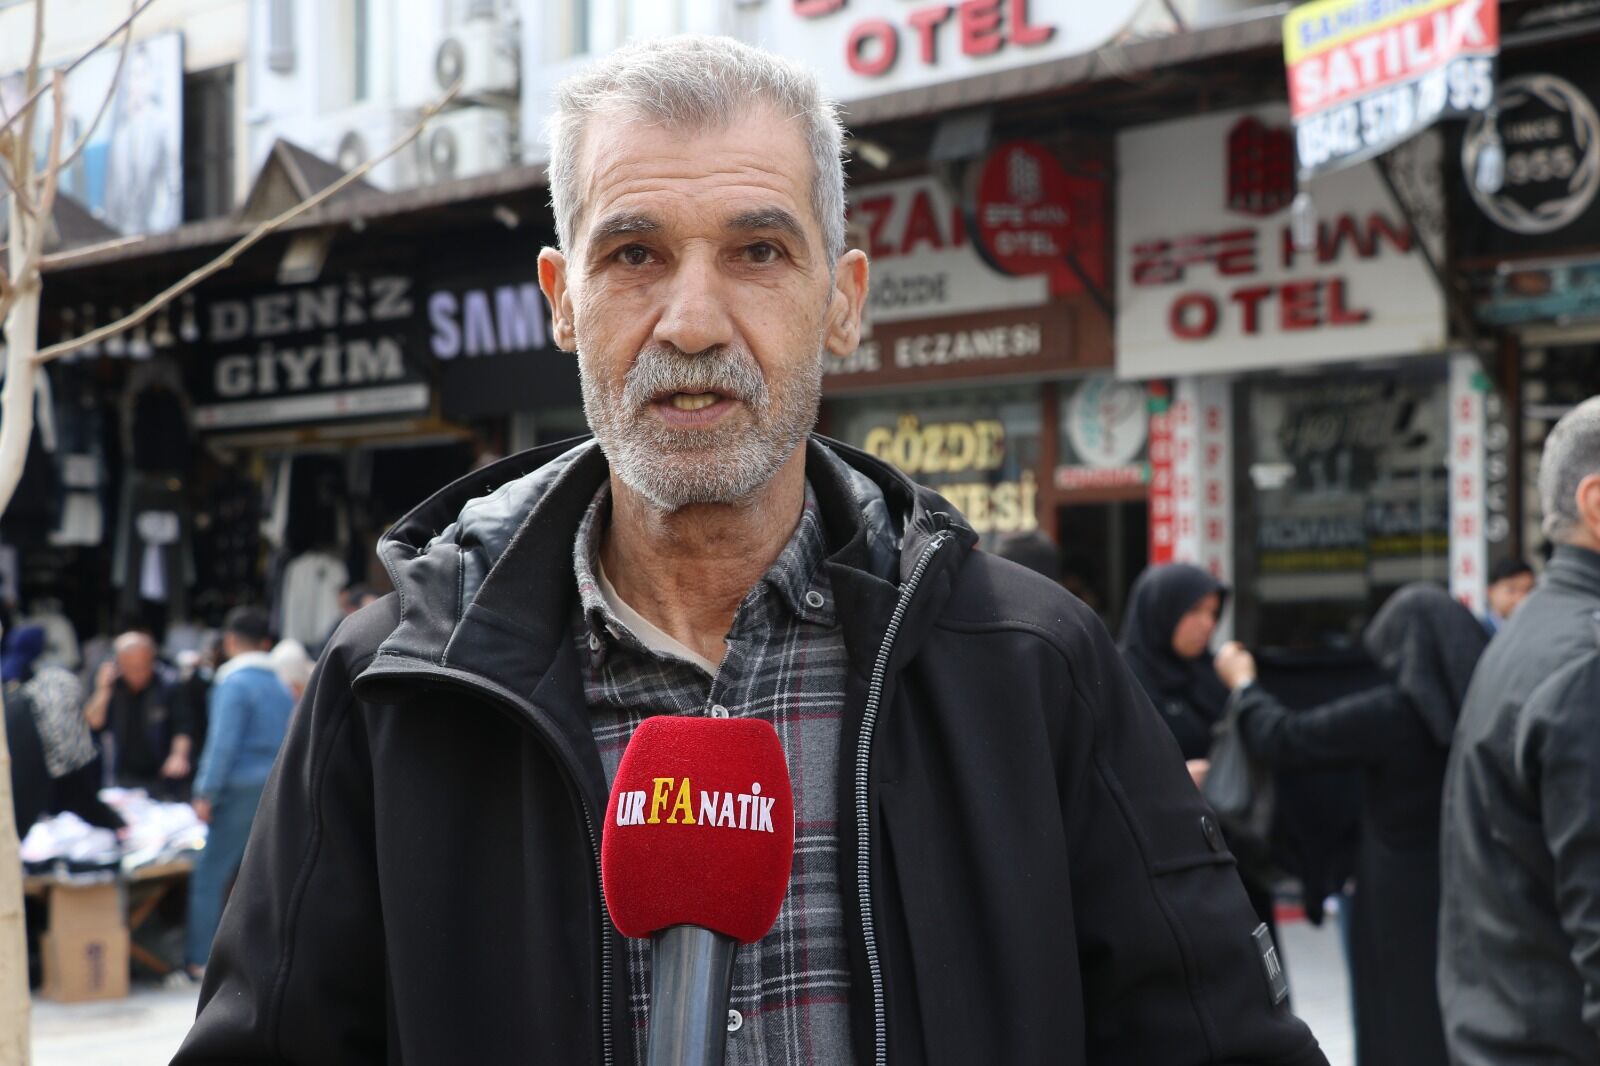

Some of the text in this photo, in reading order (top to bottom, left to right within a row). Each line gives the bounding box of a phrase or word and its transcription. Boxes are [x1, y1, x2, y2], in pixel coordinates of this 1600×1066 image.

[846, 0, 1056, 77] OTEL
[1296, 0, 1486, 106] SATILIK
[1502, 145, 1574, 185] 955
[211, 274, 411, 341] DENİZ
[428, 282, 554, 359] SAM
[1168, 277, 1373, 341] OTEL
[215, 332, 405, 397] GİYİM
[895, 321, 1042, 369] ECZANESİ
[864, 413, 1006, 476] GÖZDE
